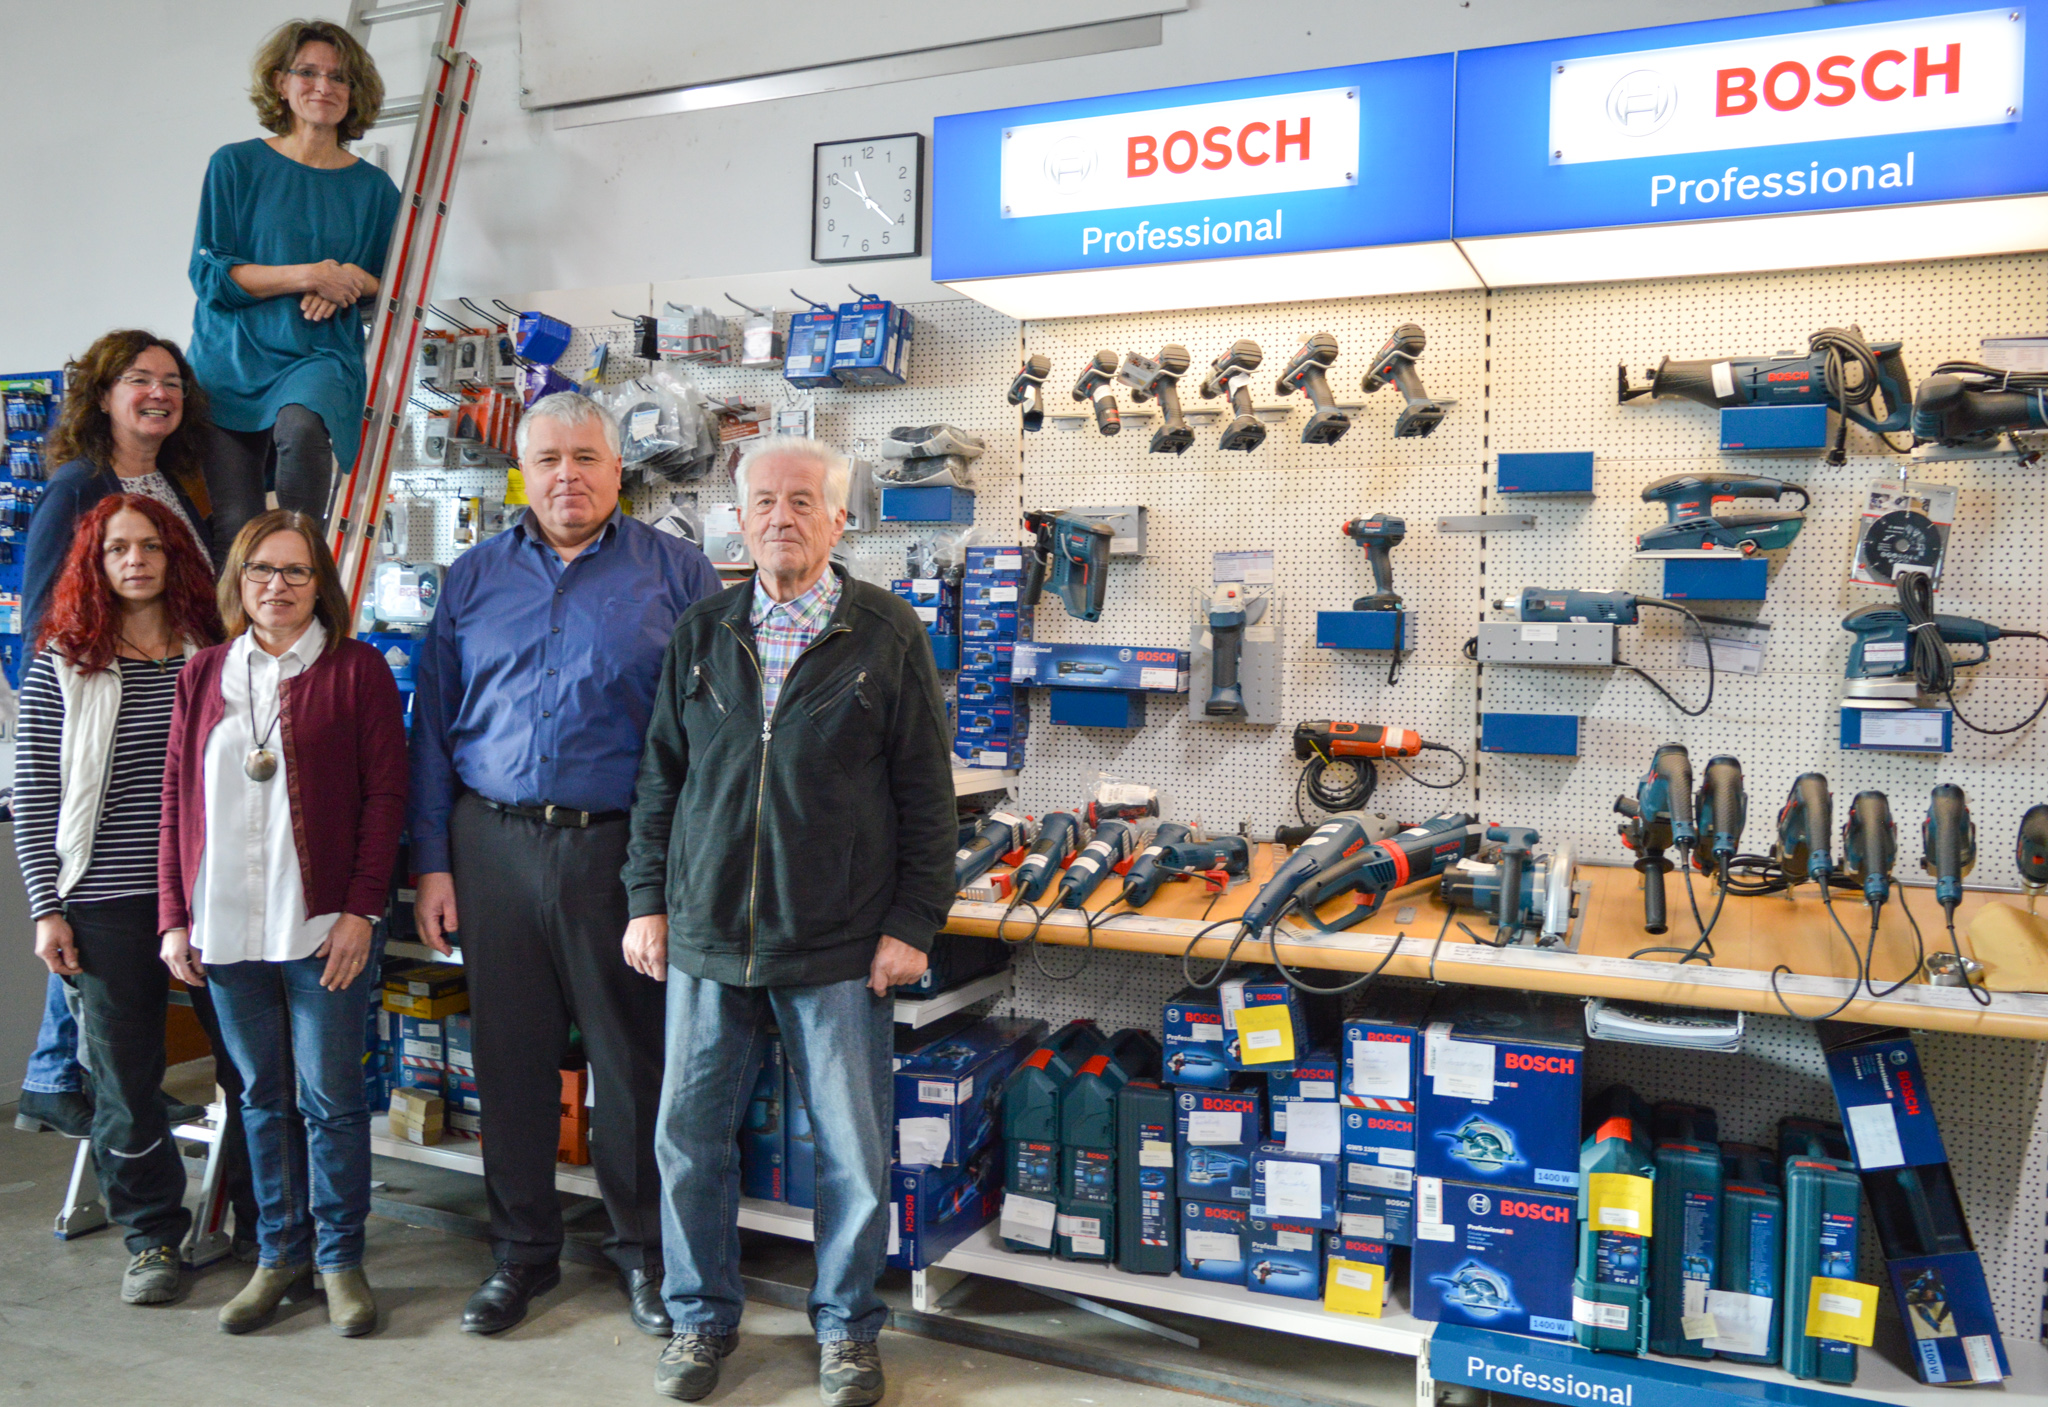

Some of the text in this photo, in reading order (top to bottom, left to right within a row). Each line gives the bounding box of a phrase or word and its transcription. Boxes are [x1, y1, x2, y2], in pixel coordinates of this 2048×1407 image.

[1716, 43, 1961, 117] BOSCH
[861, 146, 875, 160] 12
[1127, 117, 1311, 178] BOSCH
[842, 155, 852, 167] 11
[886, 150, 891, 163] 1
[826, 172, 840, 186] 10
[898, 166, 907, 180] 2
[1650, 151, 1915, 207] Professional
[903, 189, 912, 202] 3
[822, 196, 831, 210] 9
[827, 219, 836, 232] 8
[897, 213, 906, 226] 4
[881, 231, 890, 245] 5
[1082, 209, 1283, 255] Professional
[842, 234, 850, 248] 7
[861, 239, 870, 252] 6
[1767, 371, 1810, 382] BOSCH
[1136, 651, 1176, 662] BOSCH
[1342, 838, 1364, 858] BOSCH
[1435, 840, 1460, 854] BOSCH
[1367, 1032, 1411, 1044] BOSCH
[1505, 1052, 1574, 1074] BOSCH
[1292, 1068, 1334, 1080] BOSCH
[1876, 1053, 1892, 1090] Professional
[1897, 1071, 1920, 1116] BOSCH
[1203, 1098, 1254, 1113] BOSCH
[1368, 1118, 1412, 1132] BOSCH
[1086, 1152, 1109, 1160] BOSCH
[772, 1168, 780, 1198] BOSCH
[1538, 1172, 1570, 1182] 1400 W
[1385, 1198, 1410, 1207] BOSCH
[905, 1194, 914, 1232] BOSCH
[1204, 1207, 1246, 1220] BOSCH
[1500, 1199, 1570, 1224] BOSCH
[1466, 1224, 1506, 1234] Professional
[1345, 1240, 1383, 1254] BOSCH
[1533, 1320, 1565, 1330] 1400 W
[1922, 1343, 1940, 1375] 1100 W
[1467, 1356, 1632, 1407] Professional
